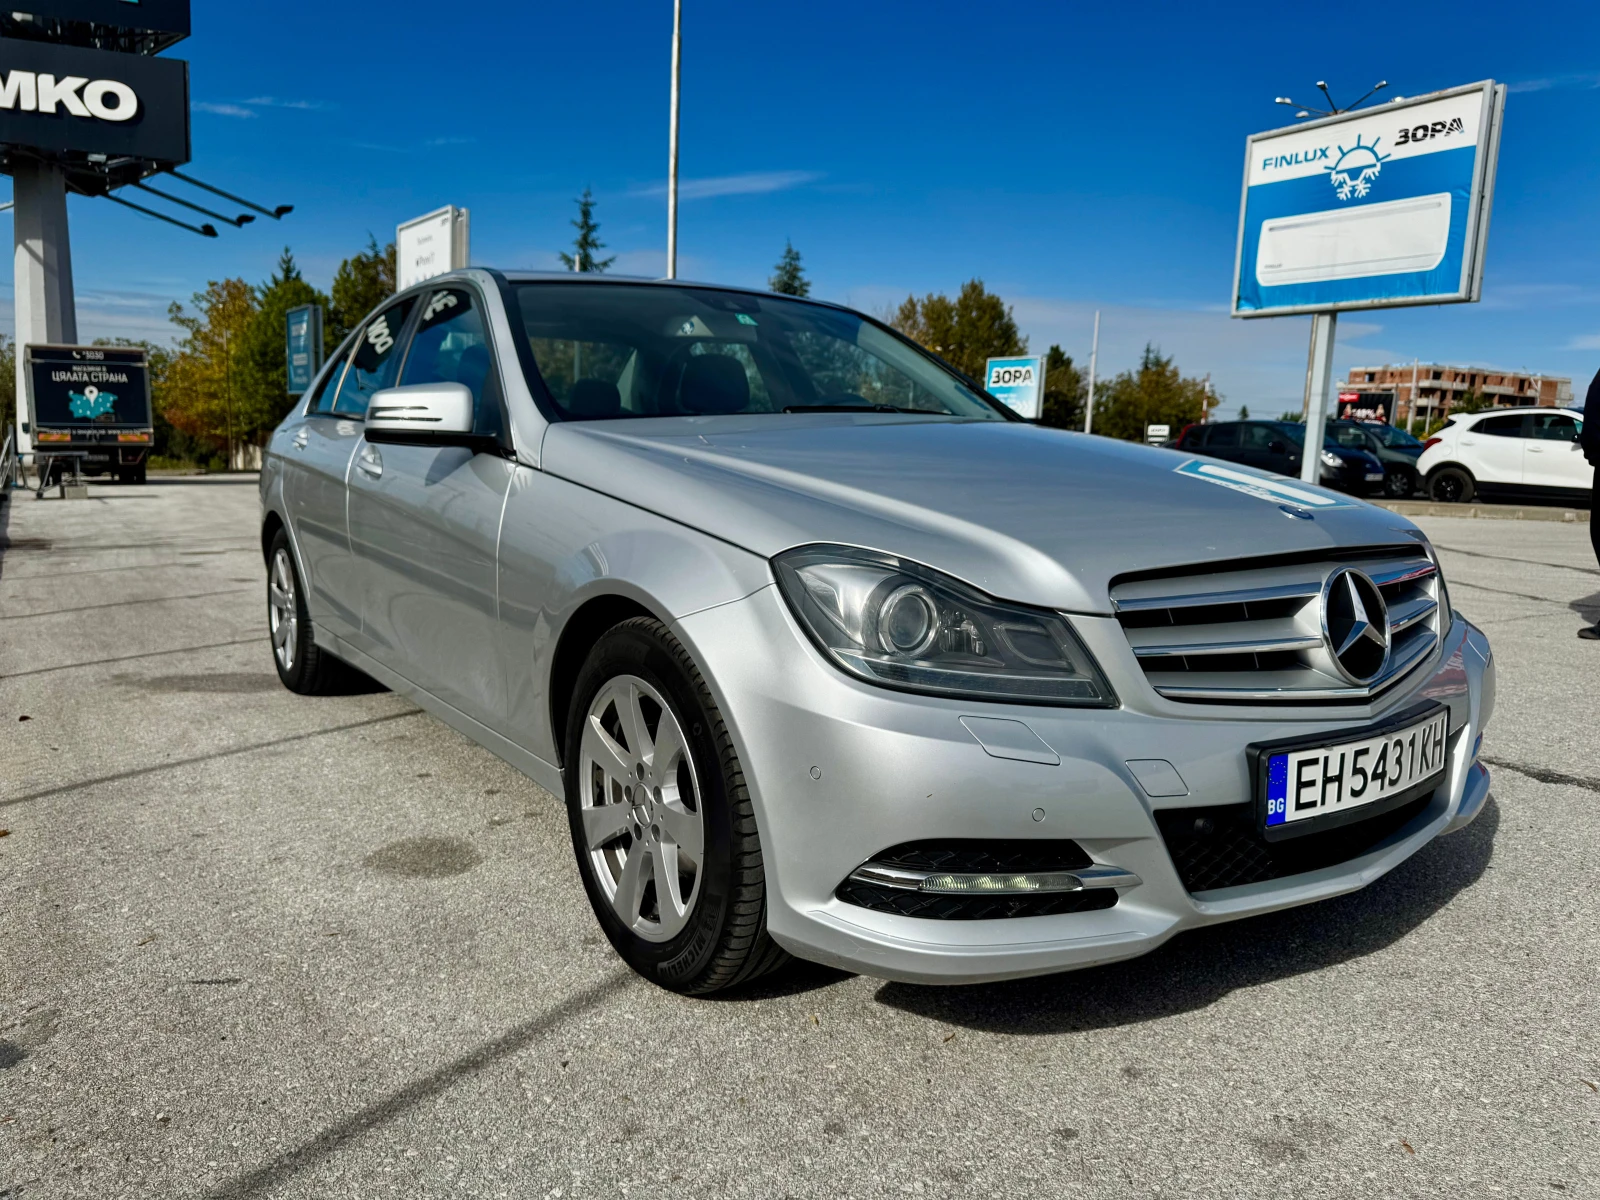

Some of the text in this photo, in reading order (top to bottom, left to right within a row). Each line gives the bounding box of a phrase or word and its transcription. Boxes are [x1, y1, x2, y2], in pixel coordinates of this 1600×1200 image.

[1394, 117, 1464, 146] ЗОРА
[1262, 145, 1330, 171] FINLUX
[52, 371, 129, 383] ЦЯЛАТА СТРАНА
[992, 369, 1032, 384] ЗОРА
[1268, 798, 1285, 816] BG
